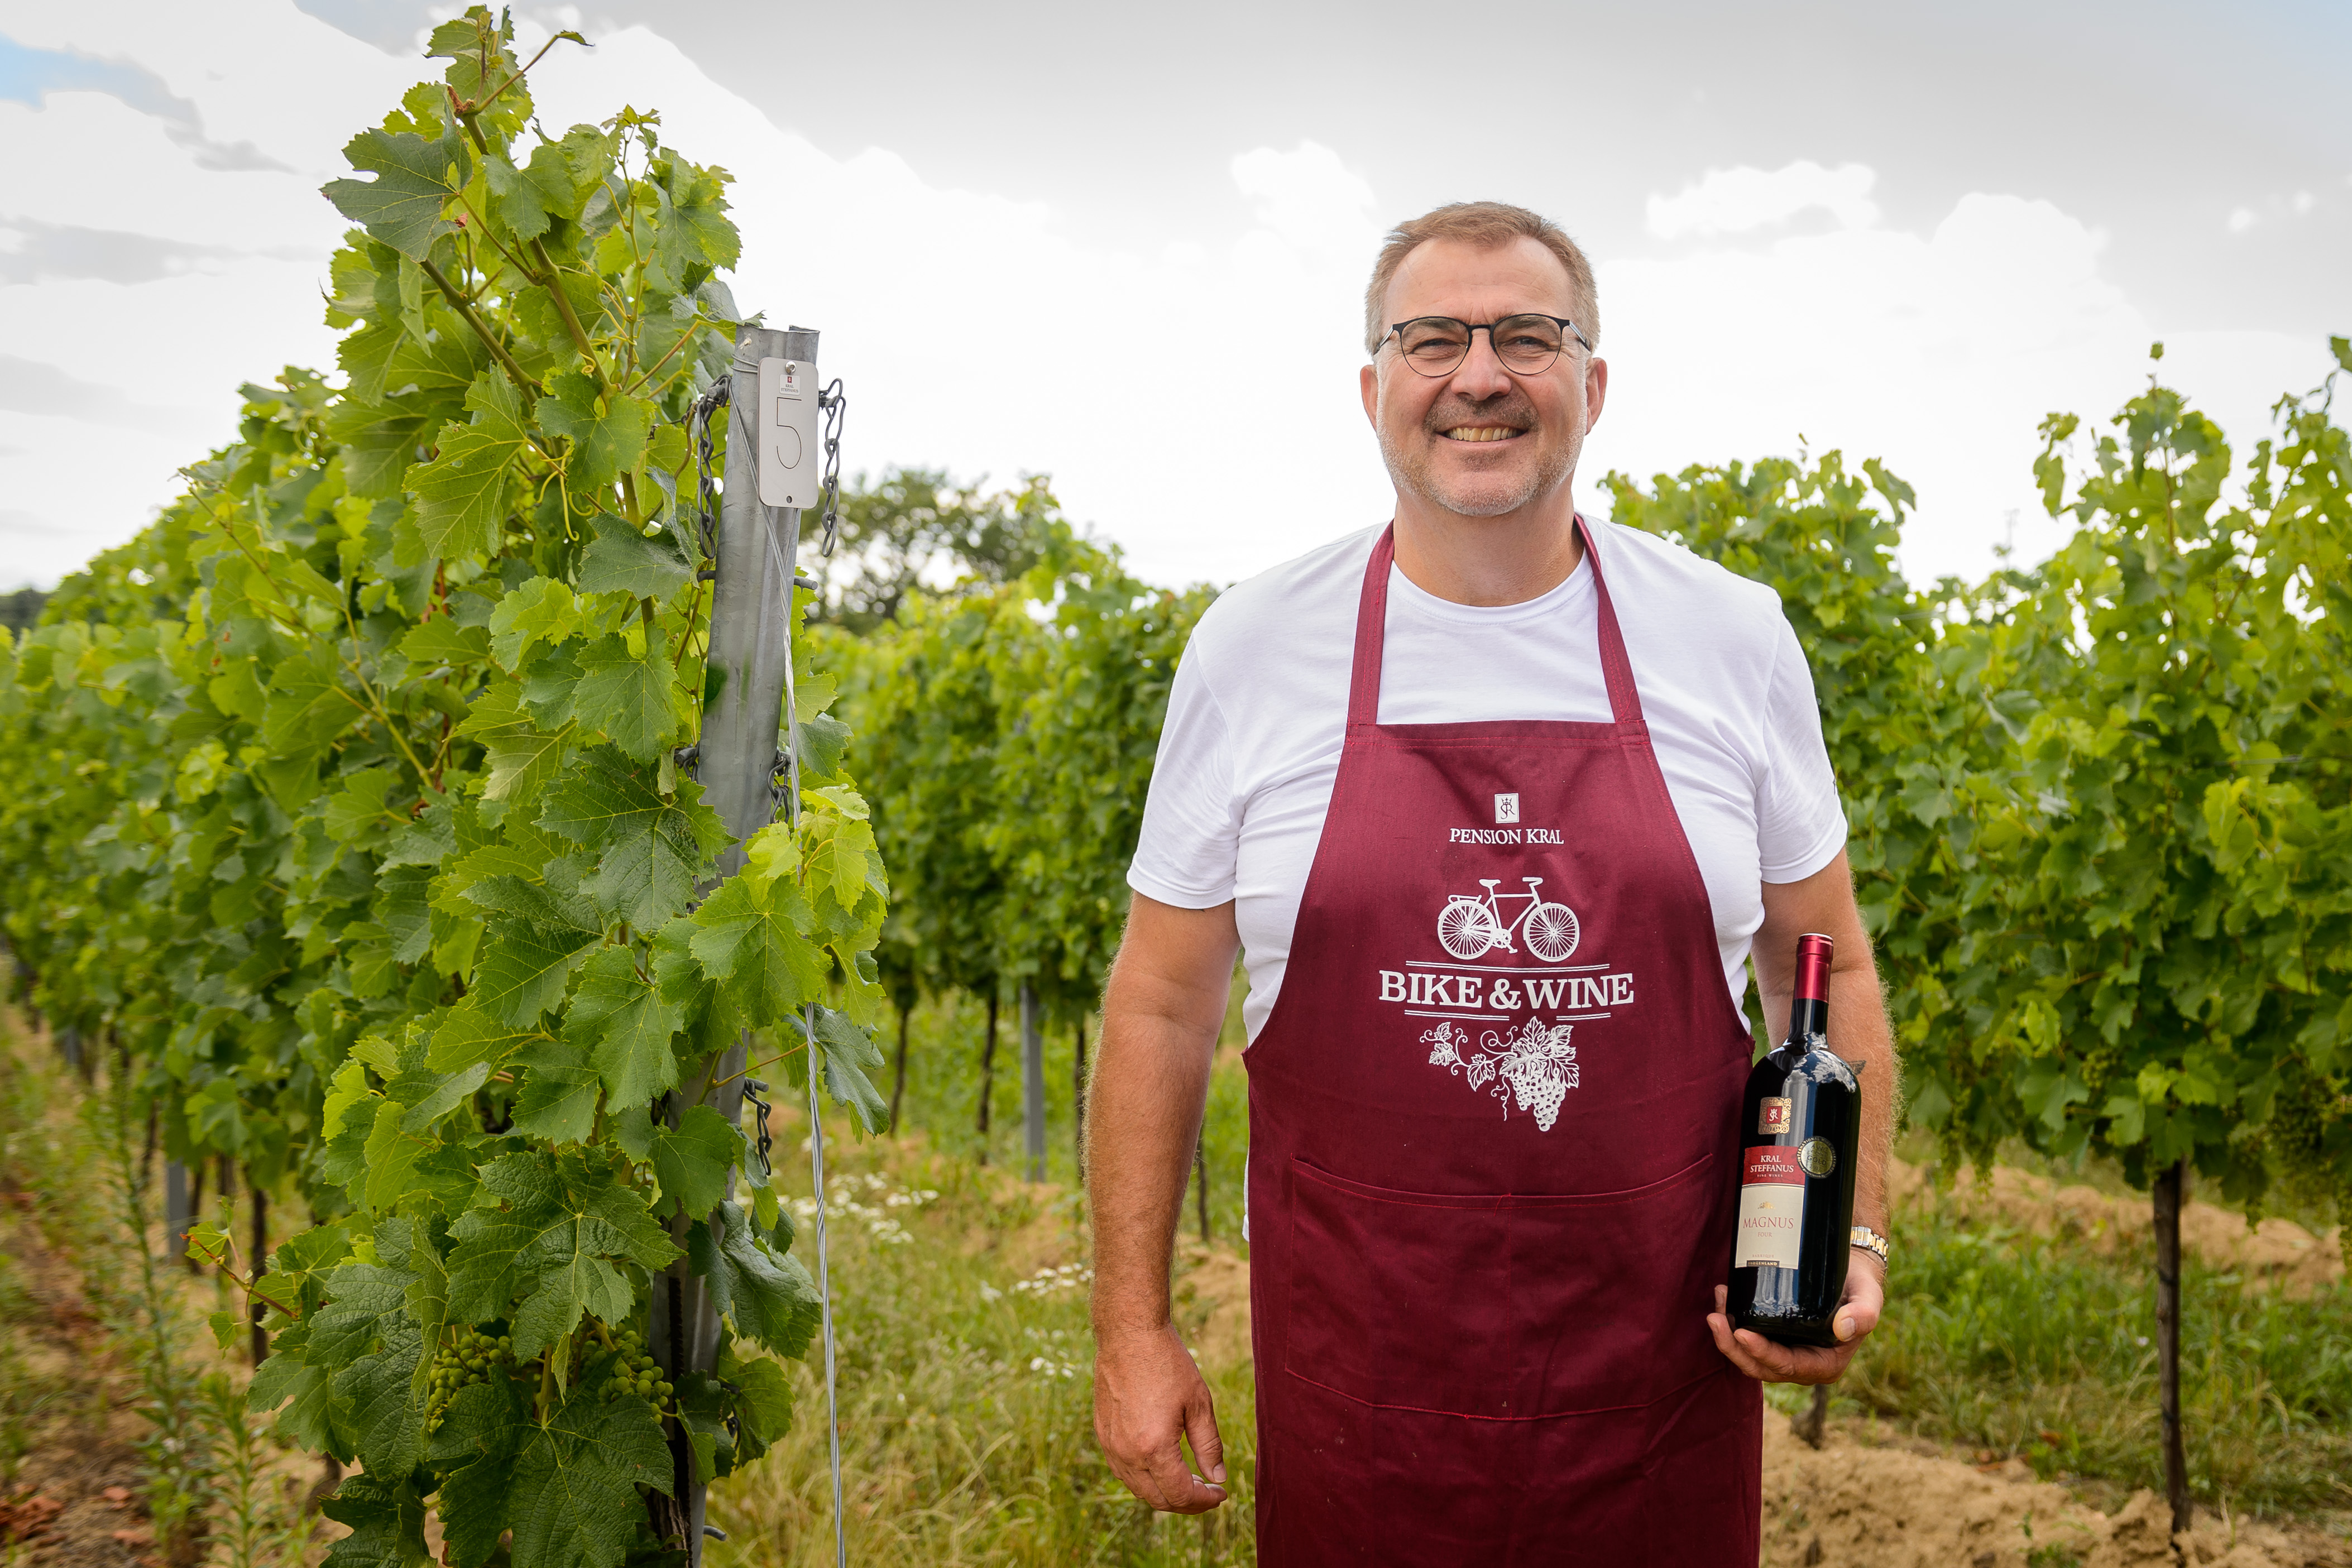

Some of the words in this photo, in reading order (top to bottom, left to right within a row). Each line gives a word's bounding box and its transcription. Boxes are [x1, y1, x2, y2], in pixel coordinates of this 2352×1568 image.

[777, 396, 802, 469] 5
[1449, 828, 1522, 845] PENSION
[1525, 828, 1564, 845] KRAL
[1378, 970, 1482, 1009] BIKE
[1522, 973, 1634, 1009] WINE
[1807, 1155, 1827, 1166] GOLD
[1750, 1164, 1794, 1173] STEFFANUS
[1742, 1216, 1794, 1229] MAGNUS
